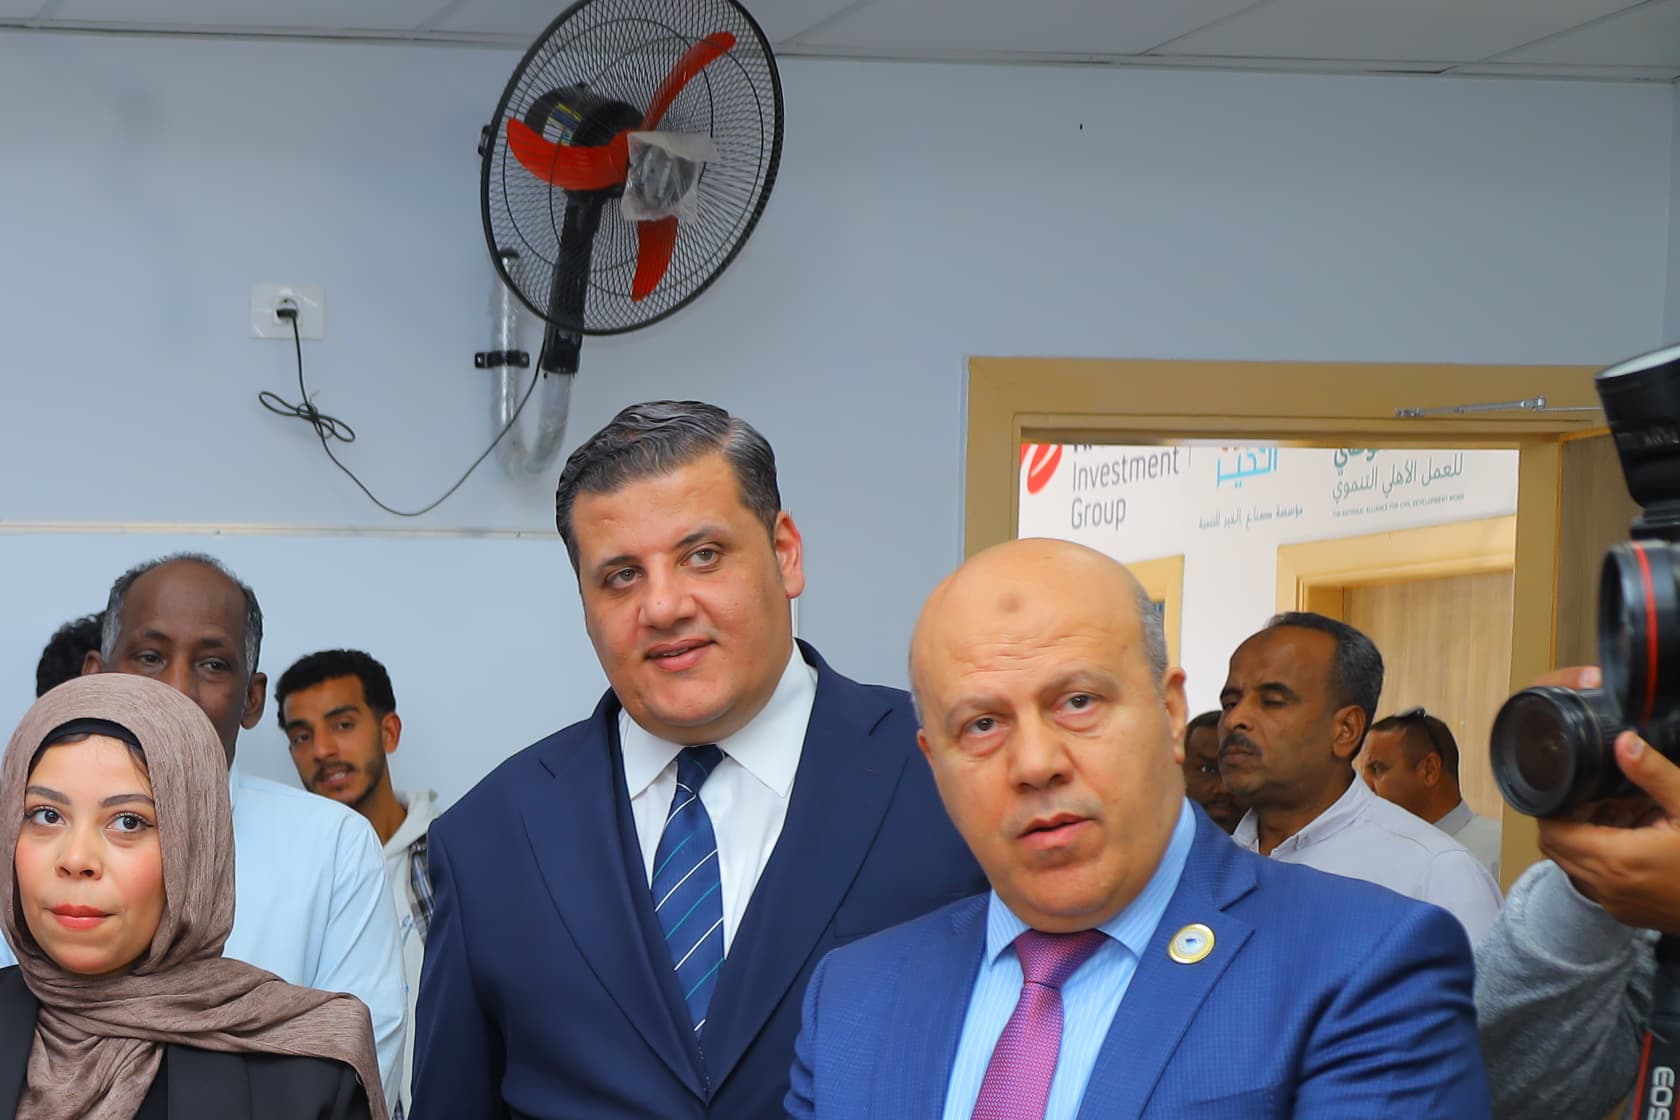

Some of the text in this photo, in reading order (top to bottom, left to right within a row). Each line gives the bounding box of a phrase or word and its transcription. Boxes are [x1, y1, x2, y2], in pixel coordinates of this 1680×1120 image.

[1072, 447, 1179, 492] Investment
[1332, 466, 1378, 504] التنموي
[1382, 459, 1417, 499] الأهلي
[1422, 452, 1464, 487] للعمل
[1071, 496, 1127, 532] Group
